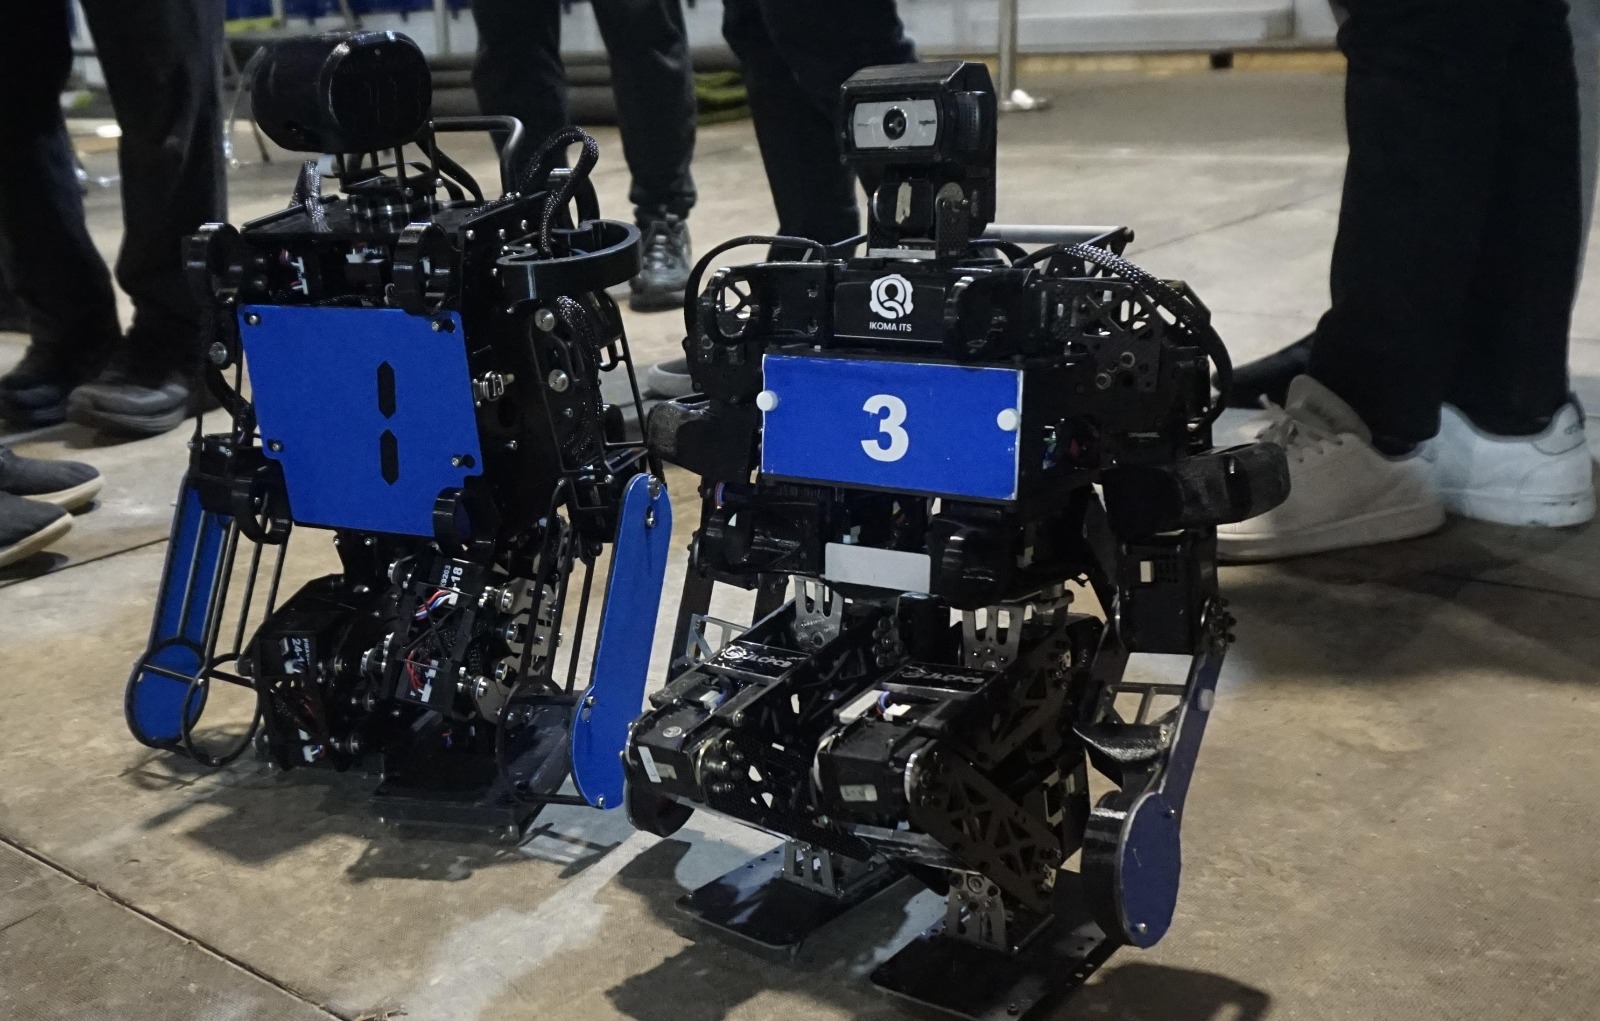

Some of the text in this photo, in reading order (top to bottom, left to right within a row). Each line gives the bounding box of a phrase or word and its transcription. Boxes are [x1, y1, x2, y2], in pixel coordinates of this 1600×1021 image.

[869, 321, 912, 332] IKOMA ITS
[860, 393, 909, 463] 3
